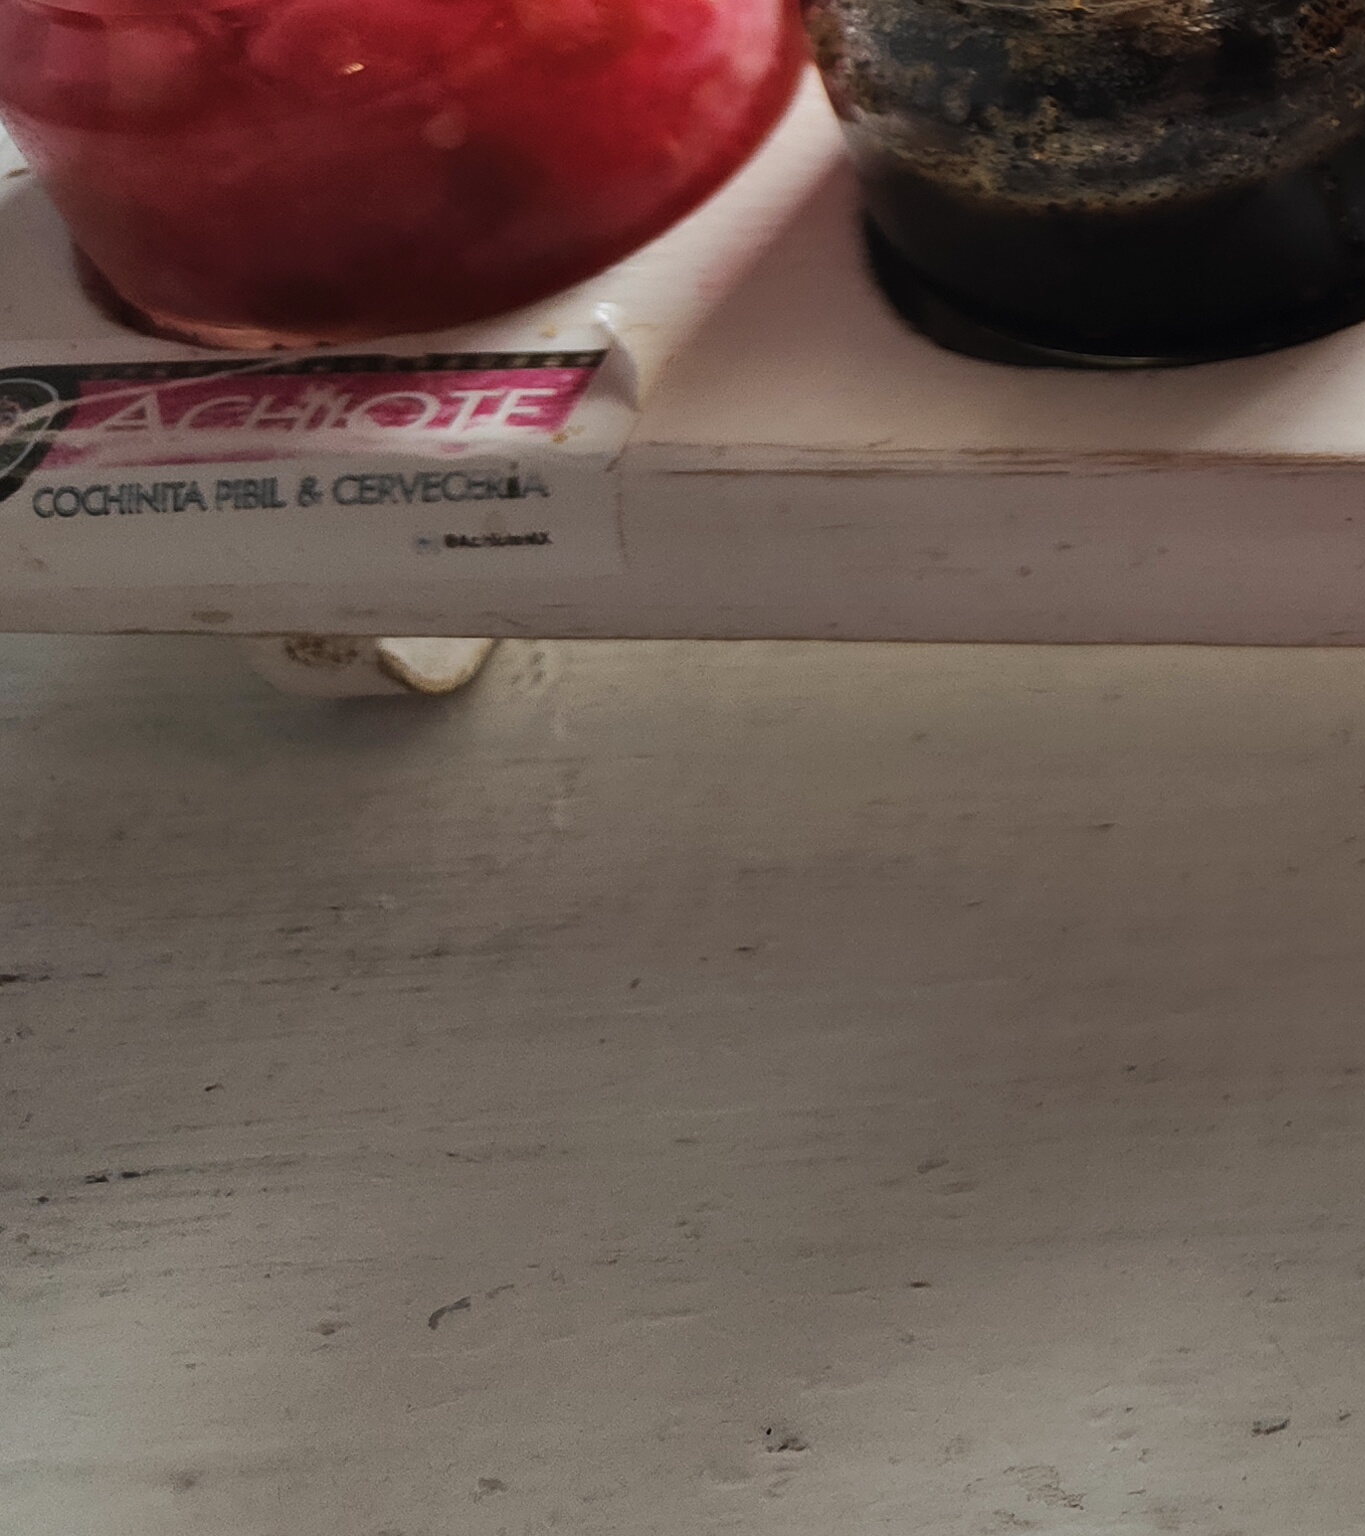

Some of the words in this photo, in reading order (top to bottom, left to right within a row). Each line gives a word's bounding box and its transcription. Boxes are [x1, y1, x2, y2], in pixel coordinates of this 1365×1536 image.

[32, 478, 208, 518] COCHINITA
[214, 475, 287, 510] PIBIL
[298, 474, 324, 508] &
